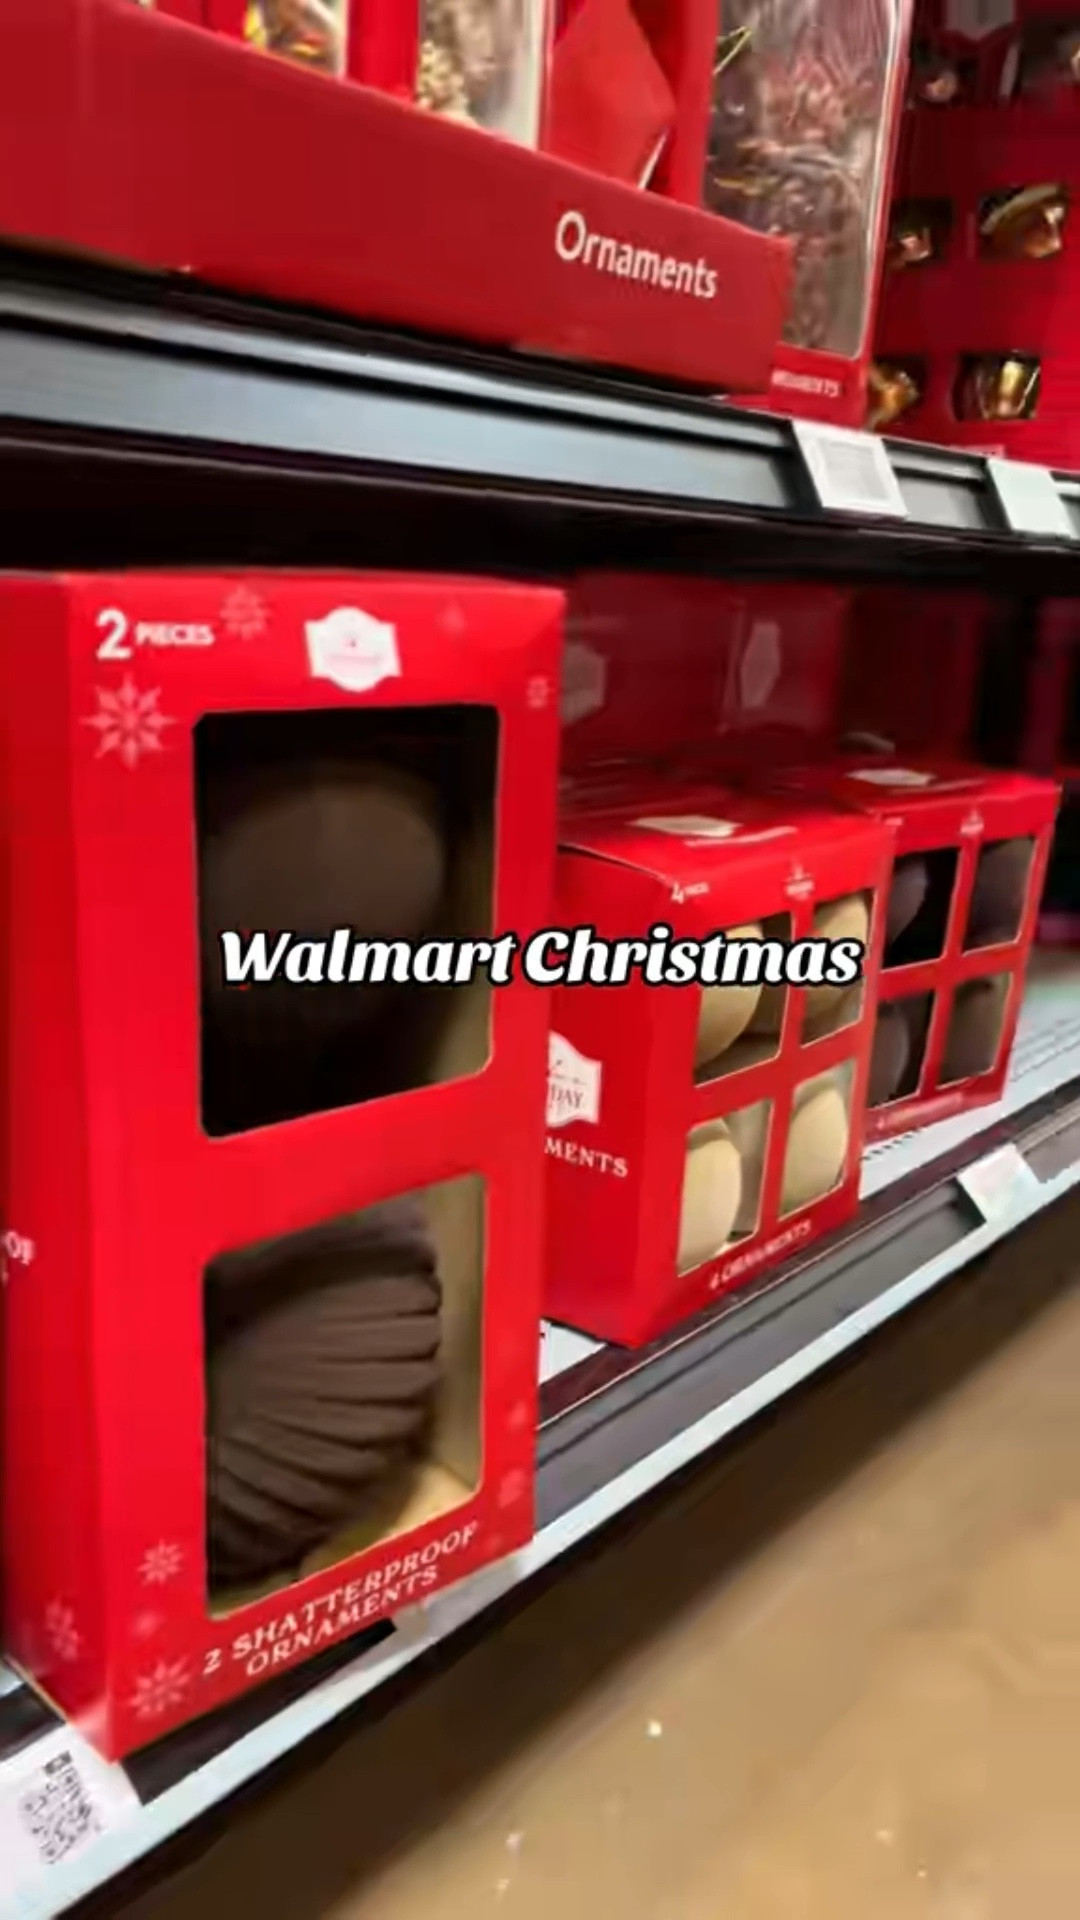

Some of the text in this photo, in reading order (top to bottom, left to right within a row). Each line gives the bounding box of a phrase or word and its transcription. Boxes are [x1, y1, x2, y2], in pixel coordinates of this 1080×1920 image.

[555, 210, 718, 298] Ornaments
[96, 607, 132, 660] 2
[202, 1520, 479, 1675] 2 SHATTERPROOF
[245, 1564, 438, 1676] ORNAMENTS
